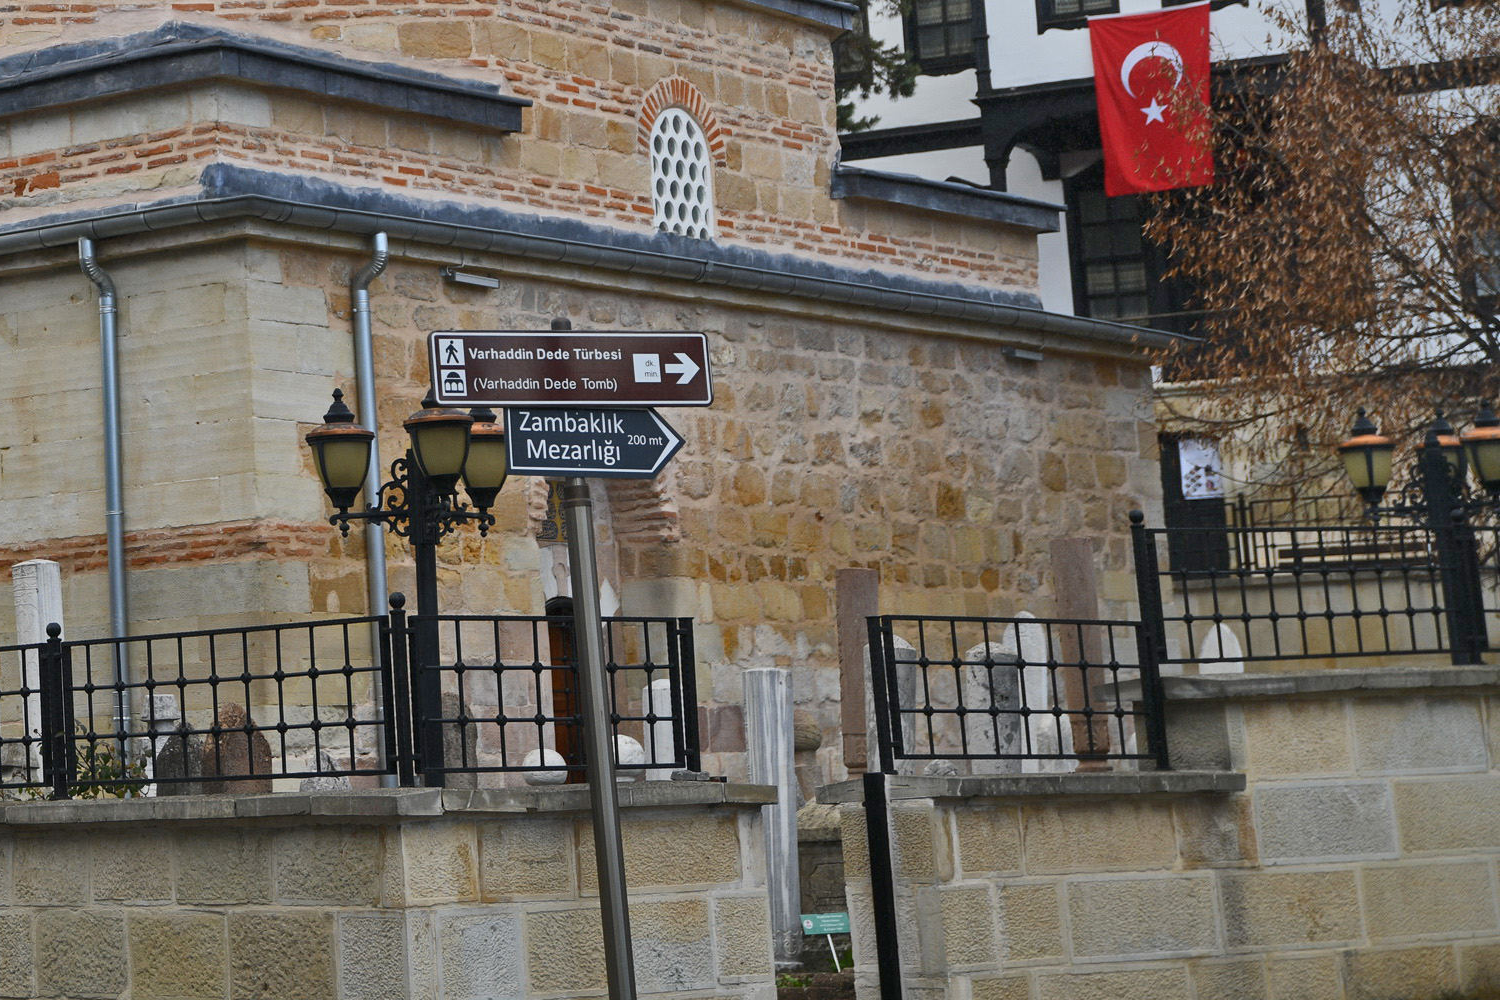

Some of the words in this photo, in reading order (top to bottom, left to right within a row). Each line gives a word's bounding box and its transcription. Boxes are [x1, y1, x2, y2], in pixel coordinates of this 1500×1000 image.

[468, 347, 534, 360] Varhaddin
[536, 348, 570, 360] Dede
[573, 348, 622, 360] Türbesi
[473, 377, 540, 392] (Varhaddin
[544, 377, 577, 390] Dede
[581, 377, 618, 392] Tomb)
[519, 411, 625, 434] Zambaklık
[627, 434, 647, 446] 200
[648, 436, 663, 446] mt
[526, 438, 621, 466] Mezarlığı
